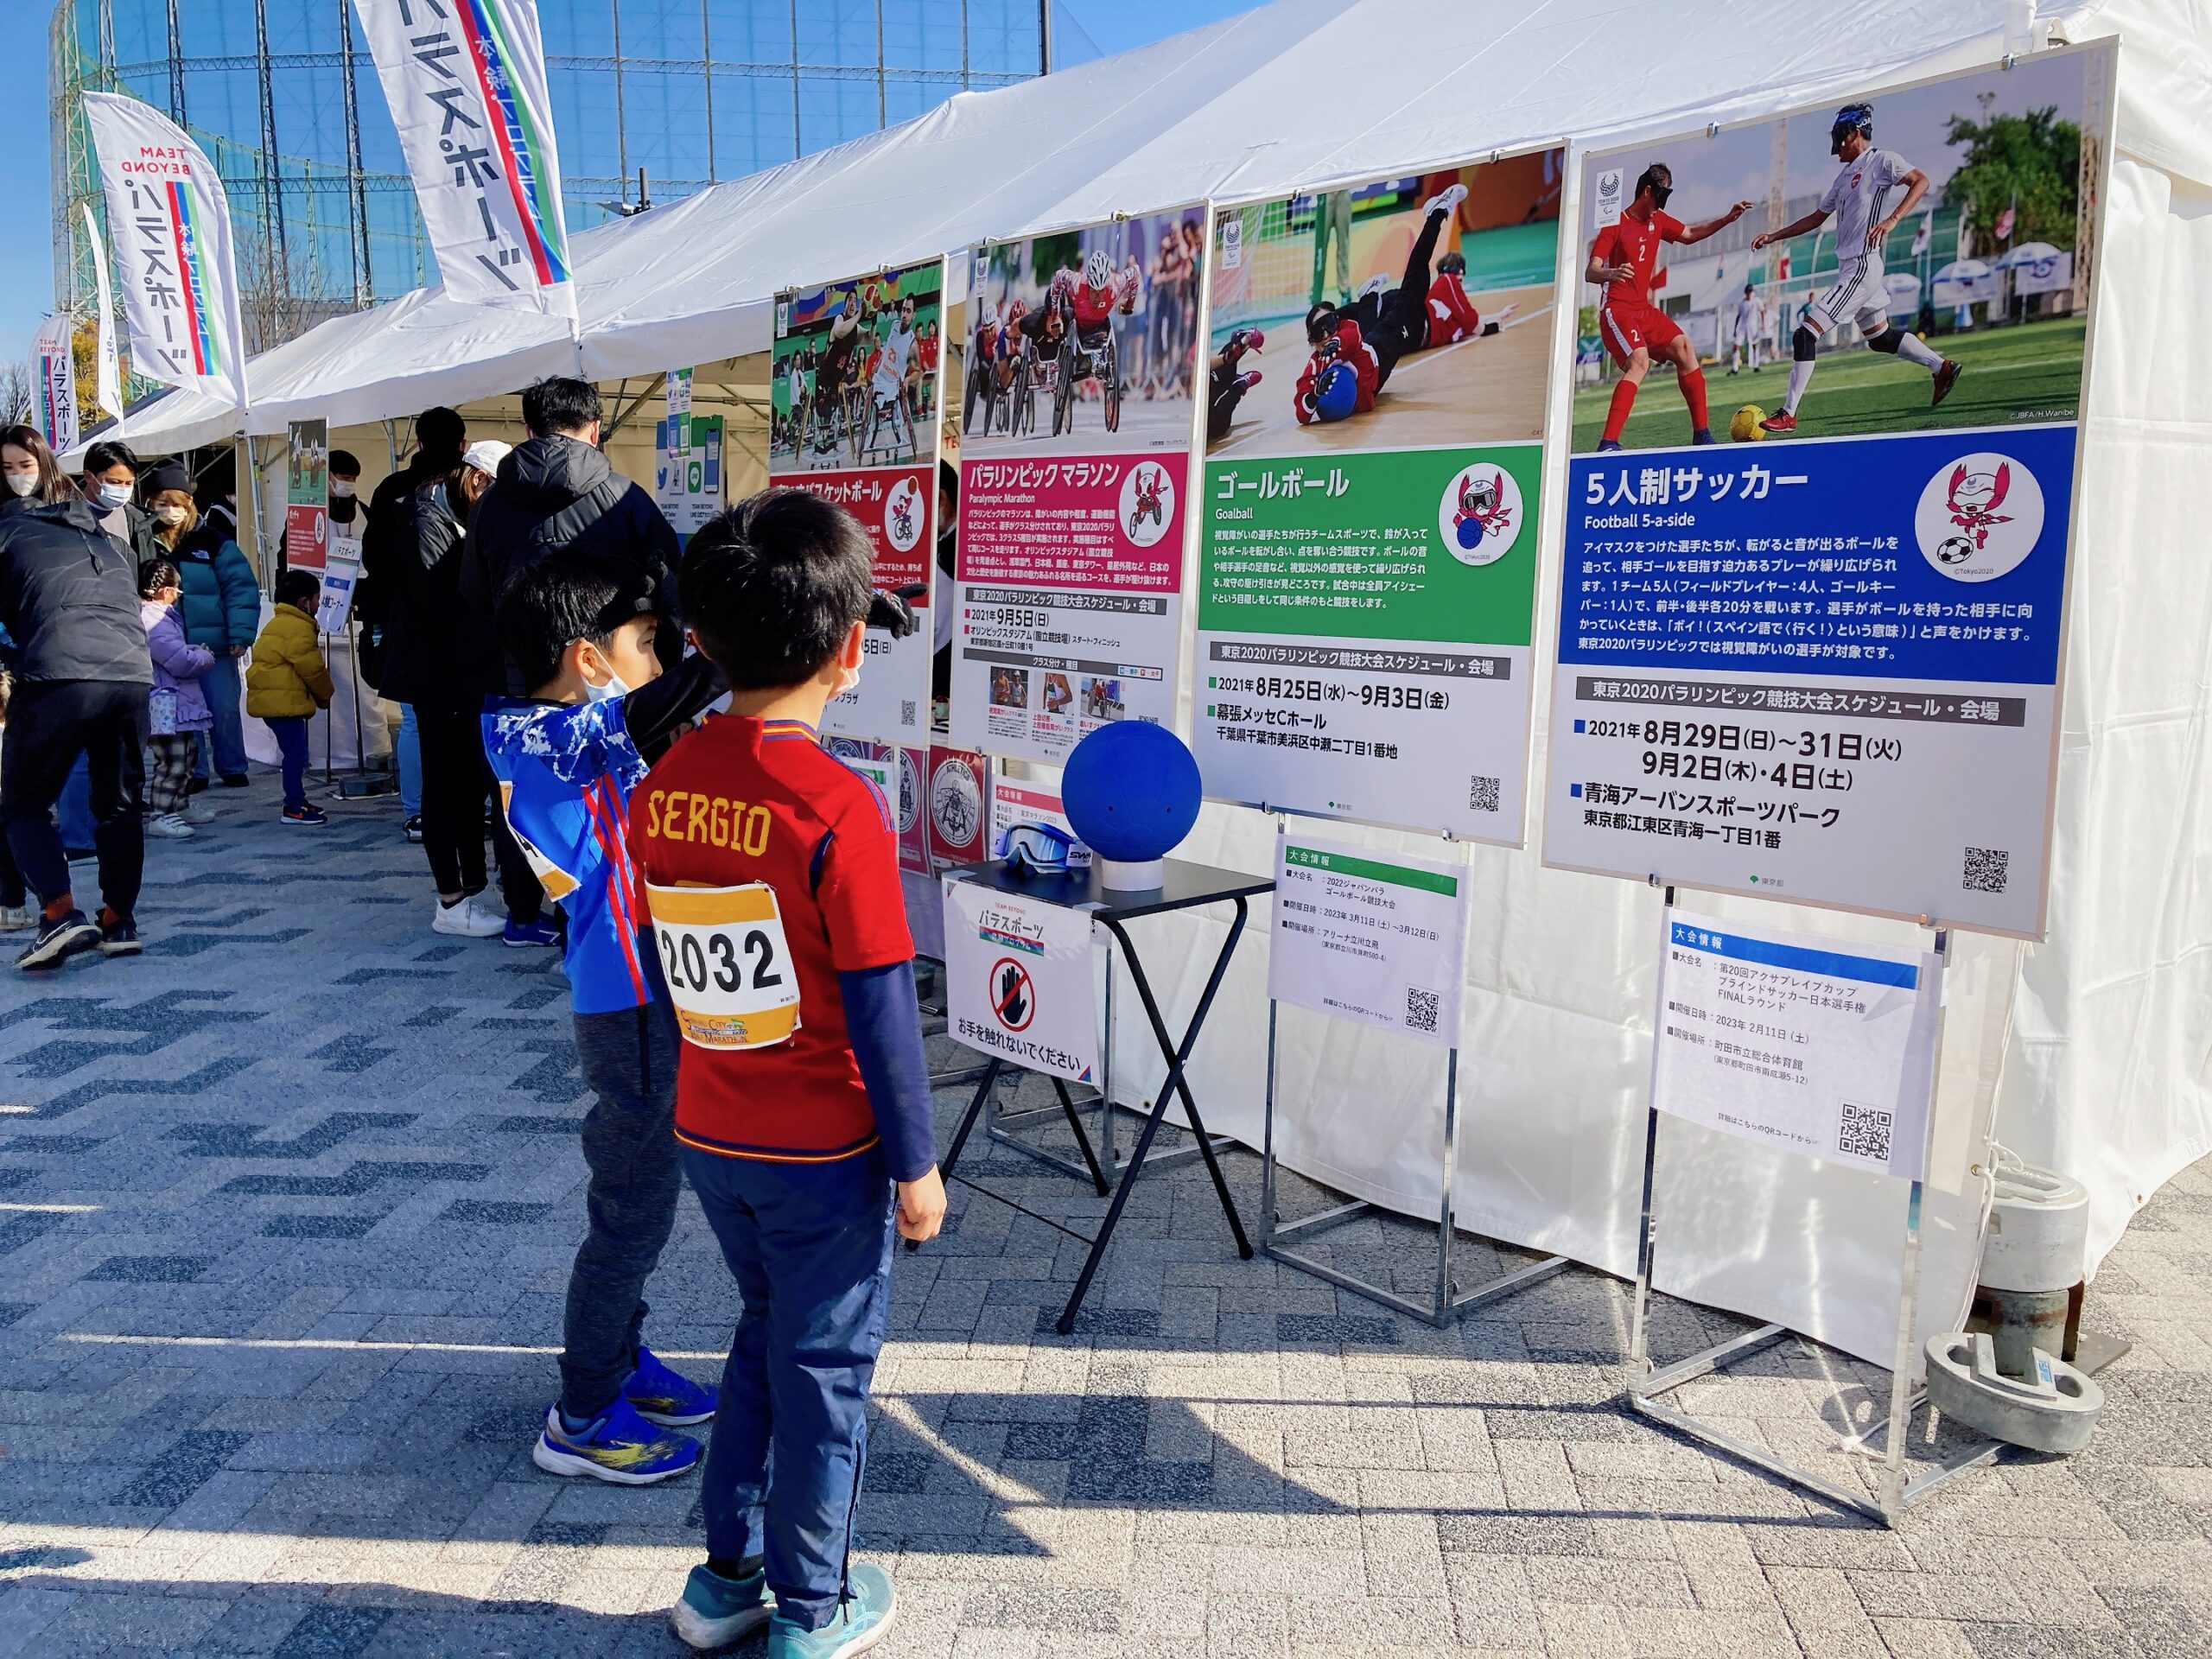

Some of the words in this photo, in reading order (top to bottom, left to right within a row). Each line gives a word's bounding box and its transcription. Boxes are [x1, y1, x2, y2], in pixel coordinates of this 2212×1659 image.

[54, 356, 71, 450] パラスポーツ
[1217, 467, 1350, 500] ゴールボール
[1586, 464, 1809, 506] 5人制サッカー
[969, 493, 1003, 505] Paralympic
[1004, 493, 1035, 504] Marathon
[1216, 507, 1254, 520] Goalball
[1585, 513, 1638, 529] Football
[1642, 512, 1695, 528] 5-a-side
[1583, 535, 1899, 553] アイマスクをつけた選手たちが、転がると音が出るボールを
[1582, 556, 1897, 574] 追って、相手ゴールを目指す迫力あるプレーが繰り広げられ
[972, 589, 1156, 613] 東京2020パラリンピック競技大会スケジュール・会場
[1220, 645, 1495, 676] 東京2020パラリンピック競技大会スケジュール・会場
[1579, 638, 1897, 660] 東京2020パラリンピックでは視覚障がいの選手が対象です。
[1592, 681, 2000, 721] 東京2020パラリンピック競技大会スケジュール・会場
[1217, 702, 1327, 730] 幕張メッセCホール
[1216, 726, 1398, 760] 千葉県千葉市美浜区中瀬二丁目1番地
[1584, 782, 1840, 830] 青海アーバンスポーツパーク
[647, 790, 772, 857] SERGIO
[1583, 809, 1783, 849] 東京都江東区青海一丁目1番
[1289, 850, 1331, 867] 大会情報
[1292, 870, 1313, 882] 大会名
[1761, 877, 1785, 887] 東京都
[979, 910, 1044, 939] パラスポーツ
[1675, 927, 1722, 950] 大会情報
[661, 929, 783, 994] 2032
[1678, 952, 1702, 968] 大会名
[1718, 988, 1786, 1013] FINALラウンド
[1719, 976, 1866, 1014] ブラインドサッカー日本選手権
[958, 1017, 1080, 1071] お手を触れないでください
